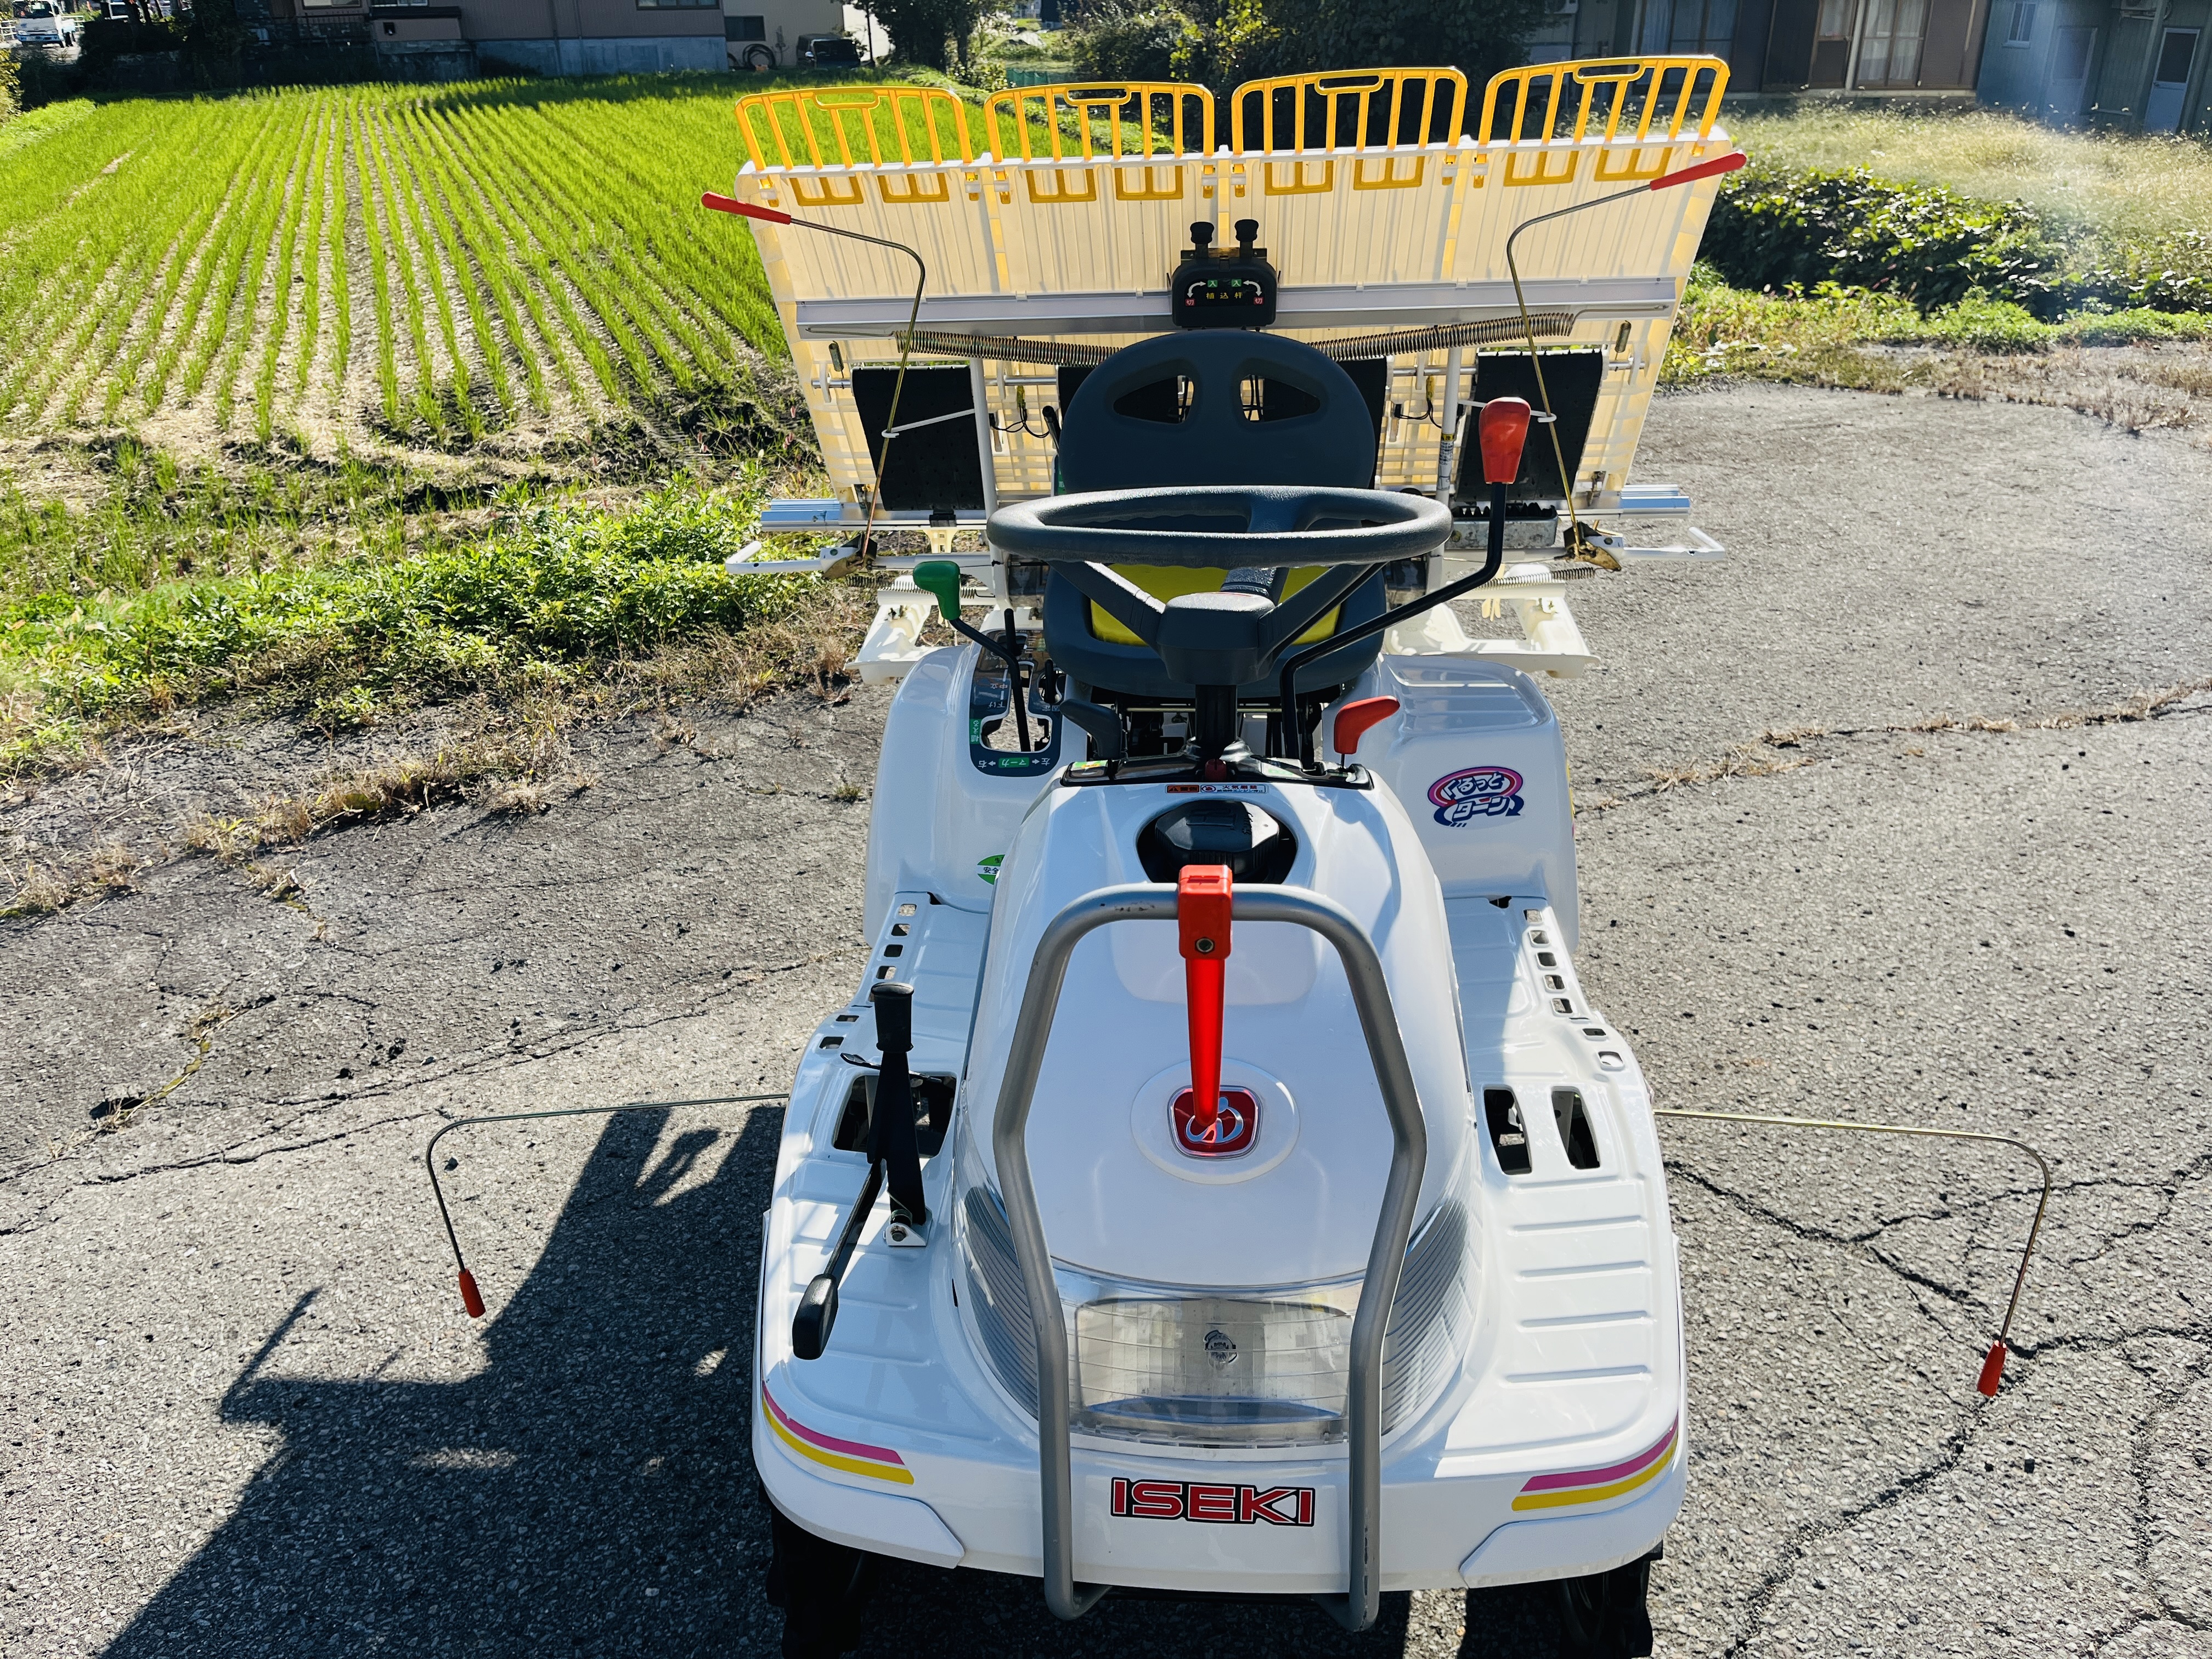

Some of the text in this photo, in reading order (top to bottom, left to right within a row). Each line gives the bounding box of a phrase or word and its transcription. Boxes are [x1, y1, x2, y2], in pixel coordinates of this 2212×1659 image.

[970, 720, 979, 742] 植える
[978, 758, 1051, 768] 左 マーカ 右
[1111, 1477, 1315, 1526] ISEKI
